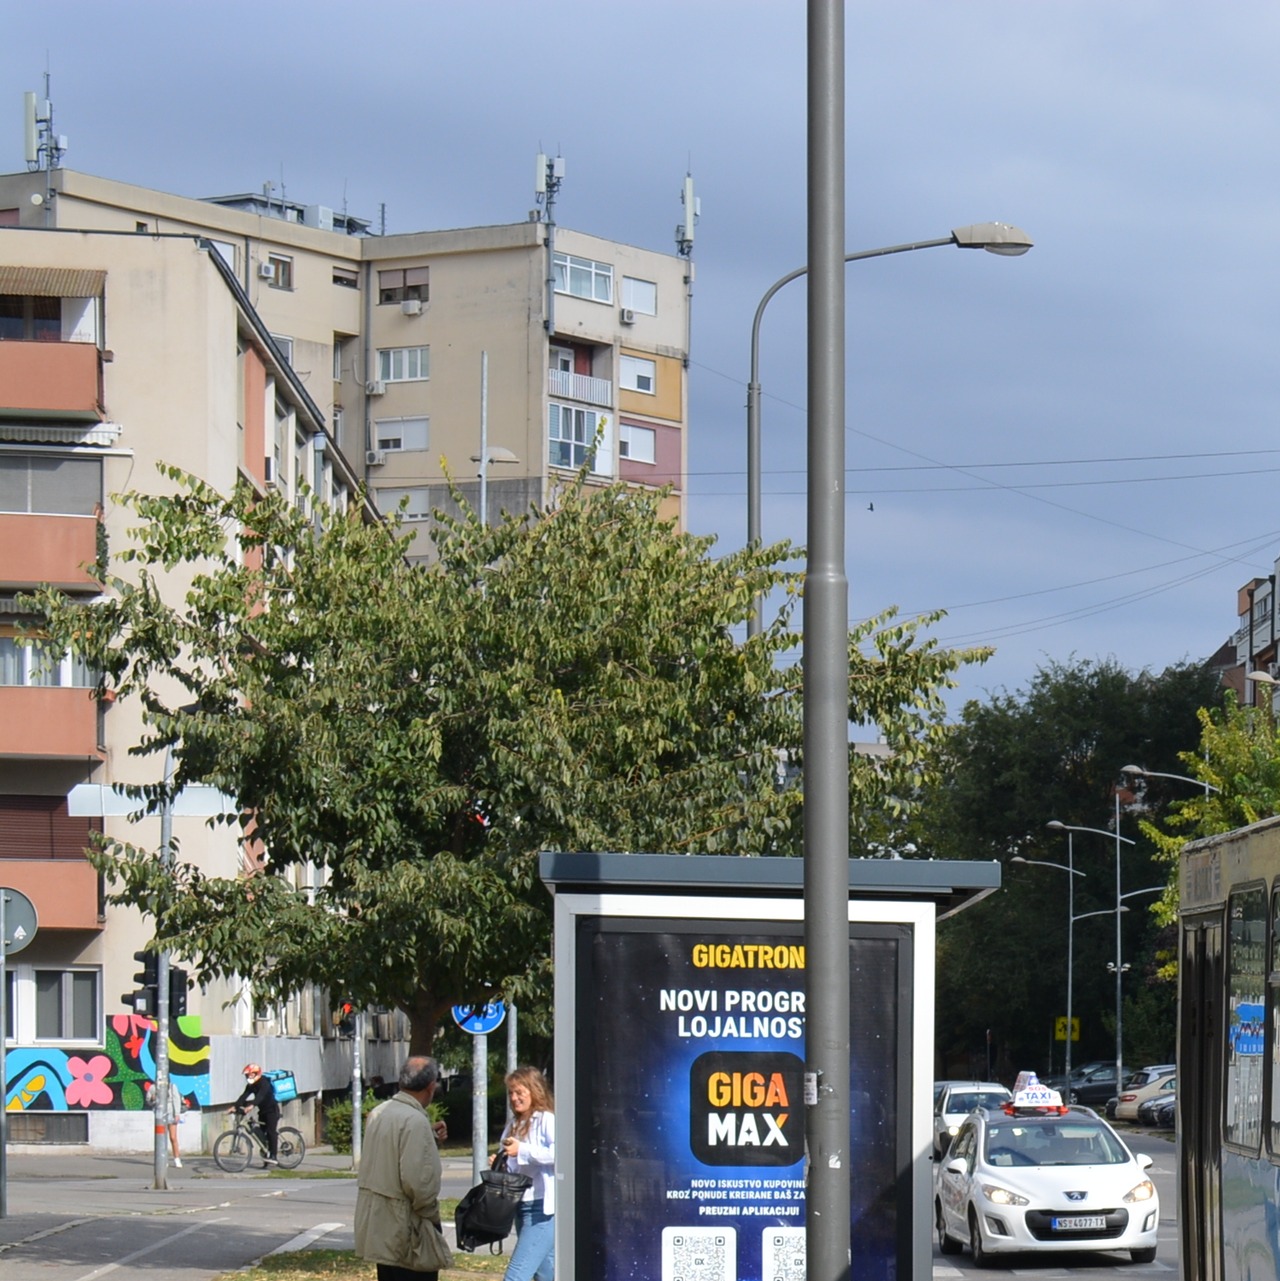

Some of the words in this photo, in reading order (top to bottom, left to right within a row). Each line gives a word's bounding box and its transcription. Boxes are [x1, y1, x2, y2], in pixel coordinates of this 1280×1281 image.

[692, 944, 806, 969] GIGATRON
[659, 989, 718, 1012] NOVI
[677, 1015, 806, 1039] LOJALNOS
[707, 1071, 790, 1108] GIGA
[1024, 1091, 1052, 1100] TAXI
[707, 1112, 790, 1147] MAX
[666, 1190, 690, 1200] KROZ
[691, 1190, 727, 1200] PONUDE
[729, 1190, 772, 1200] KREIRANE
[773, 1189, 792, 1200] BAŠ
[793, 1191, 806, 1200] ZA
[691, 1179, 717, 1189] NOVO
[717, 1179, 762, 1189] ISKUSTVO
[699, 1206, 740, 1216] PREUZMI
[741, 1206, 800, 1216] APLIKACIJU!
